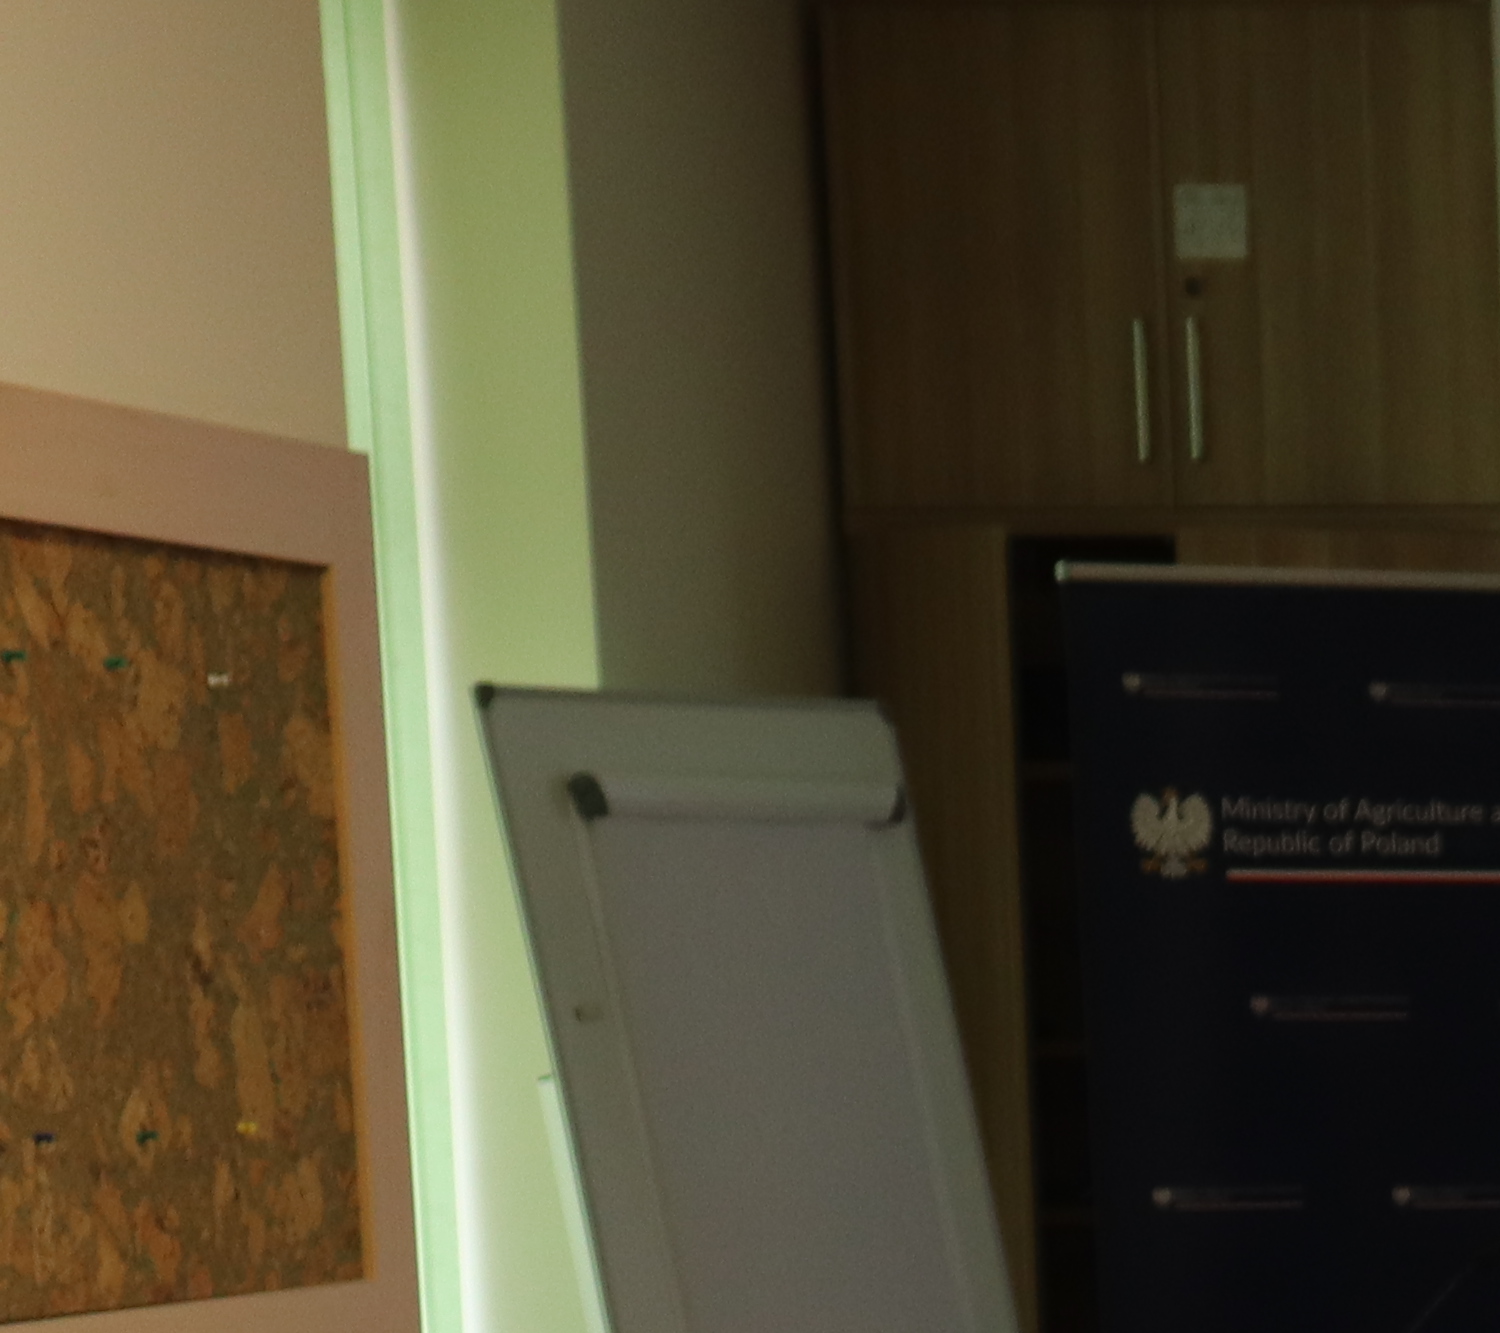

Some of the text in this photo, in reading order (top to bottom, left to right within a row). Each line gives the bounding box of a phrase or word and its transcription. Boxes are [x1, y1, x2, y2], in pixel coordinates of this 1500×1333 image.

[1221, 797, 1316, 824] Ministry
[1322, 797, 1348, 821] of
[1354, 798, 1482, 827] Agriculture
[1223, 829, 1441, 857] Republic of Poland
